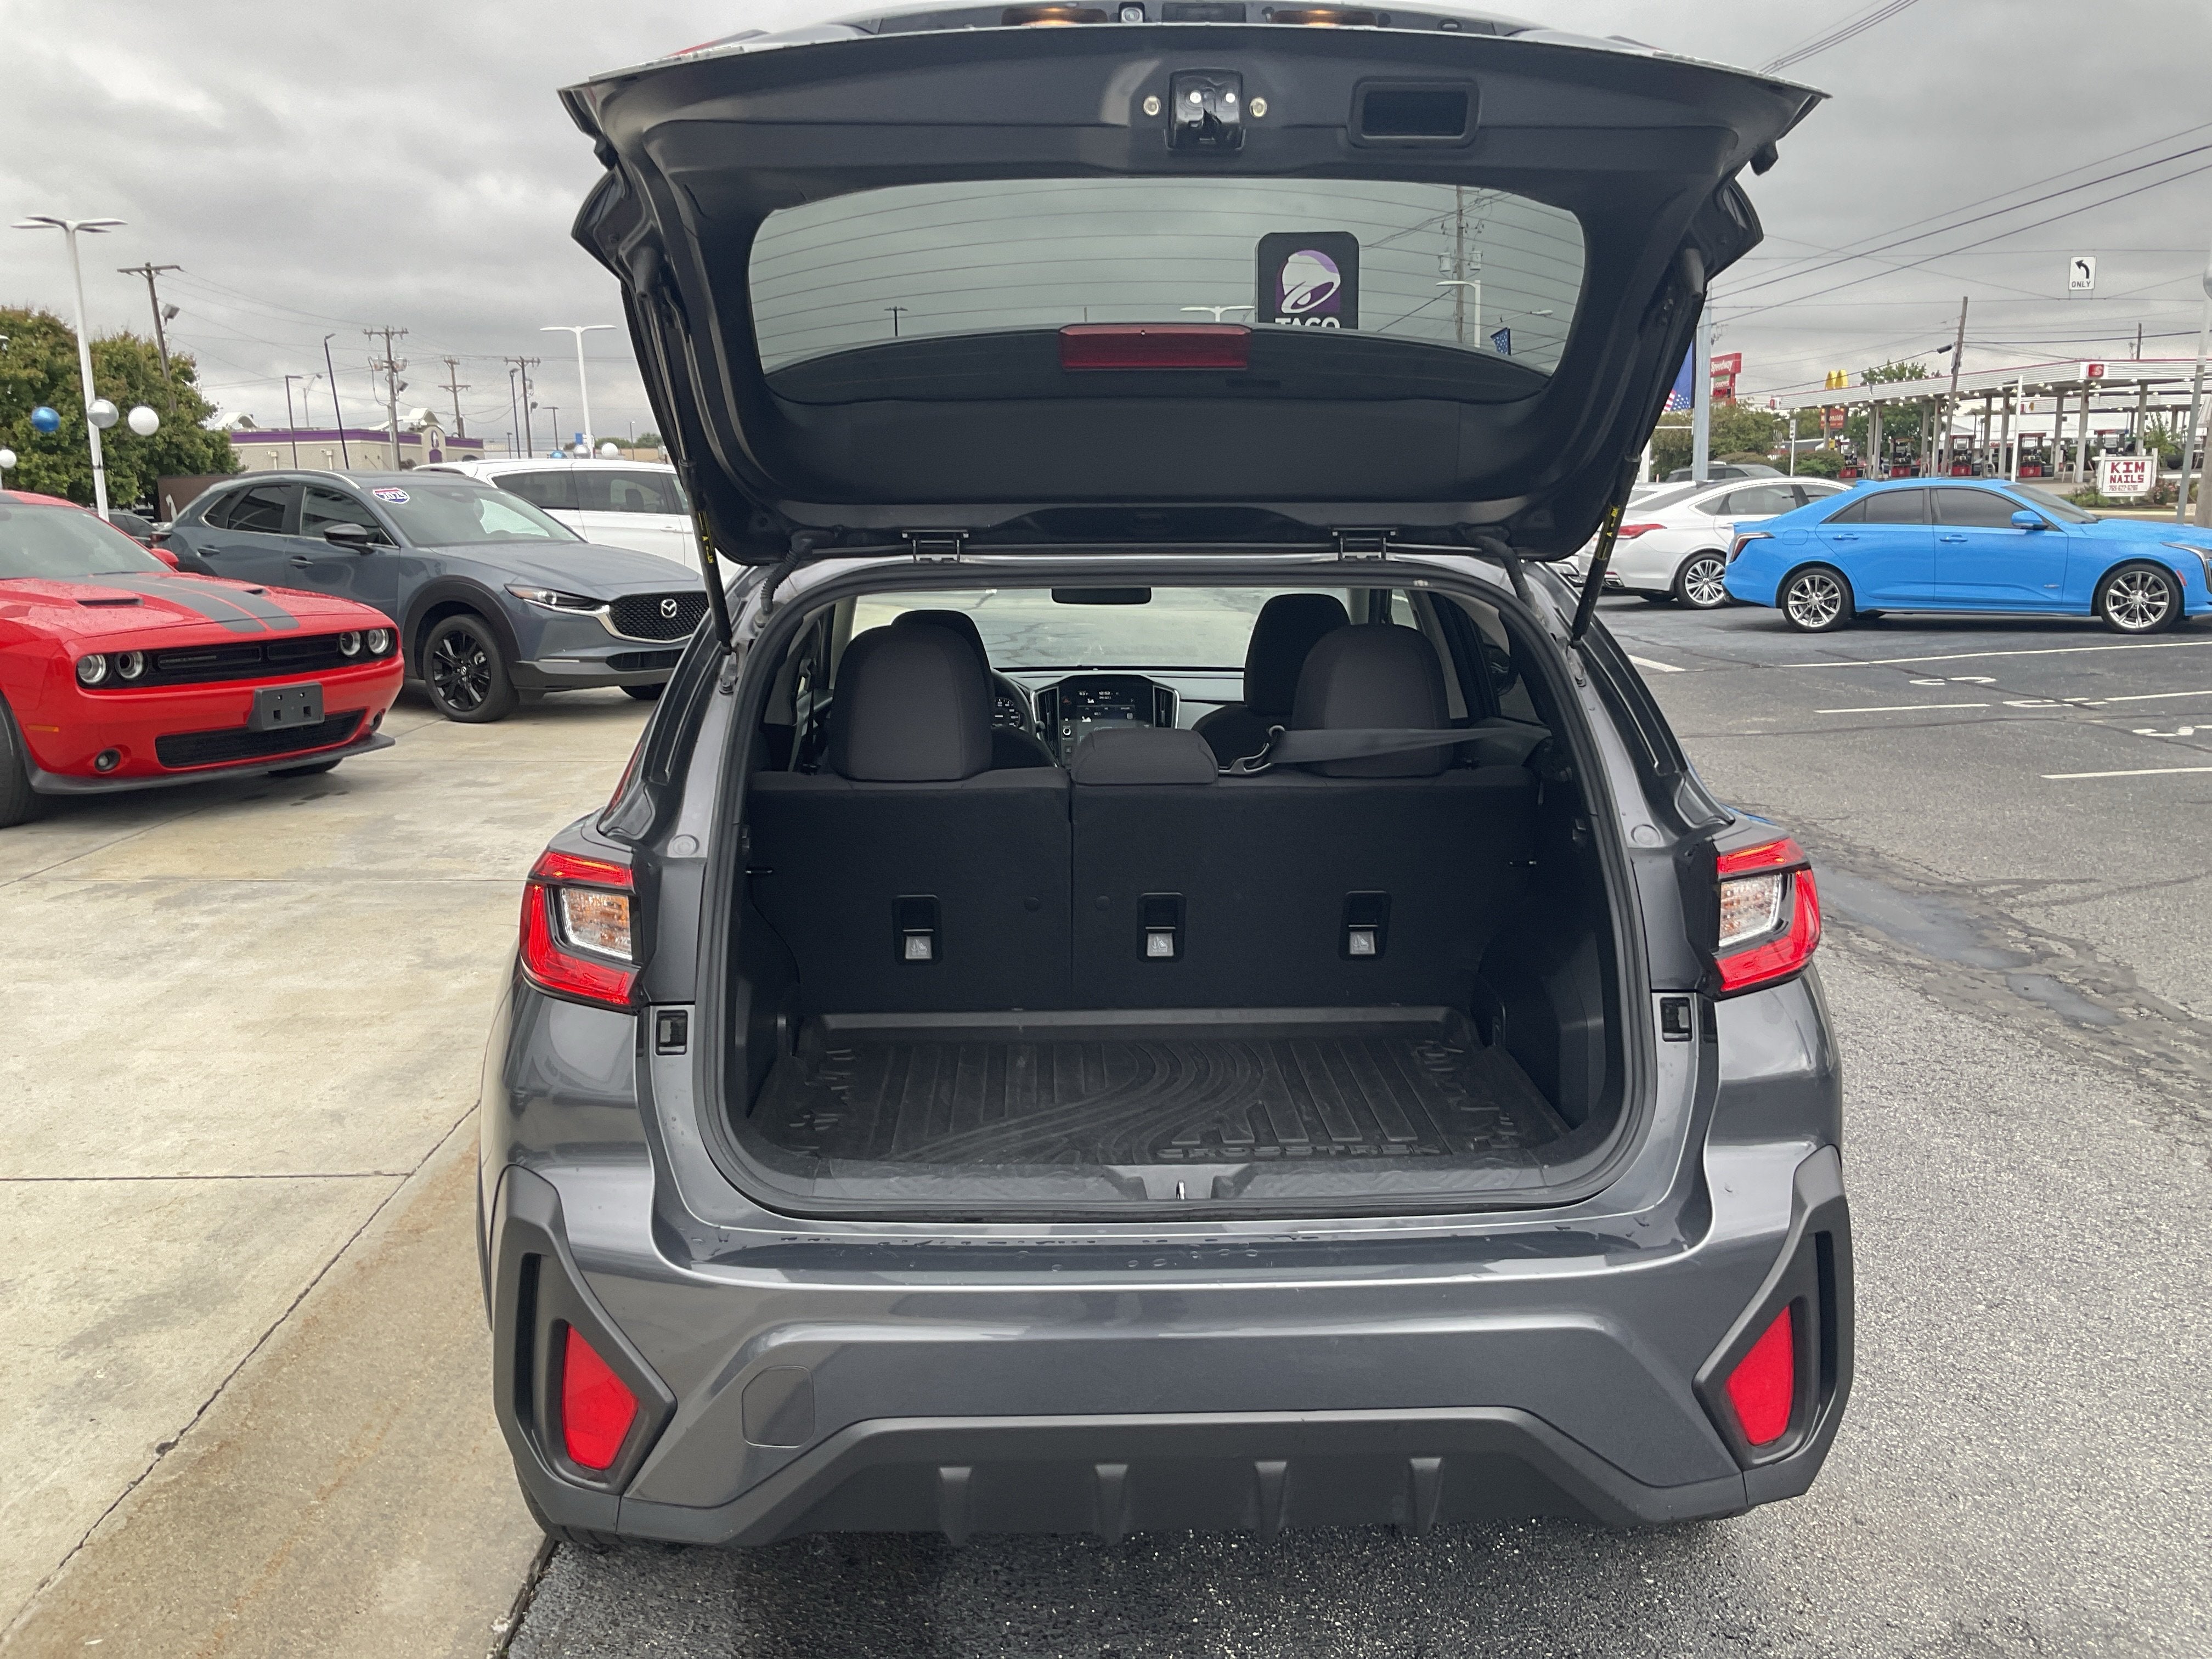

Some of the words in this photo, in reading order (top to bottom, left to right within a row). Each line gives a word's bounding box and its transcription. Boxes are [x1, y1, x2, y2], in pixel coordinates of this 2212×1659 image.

[1275, 317, 1340, 329] TACO
[1711, 359, 1733, 374] Speedway
[2111, 462, 2145, 473] KIM
[2109, 475, 2145, 483] NAILS
[381, 491, 407, 500] 2025
[1157, 1144, 1440, 1158] CROSSTREK
